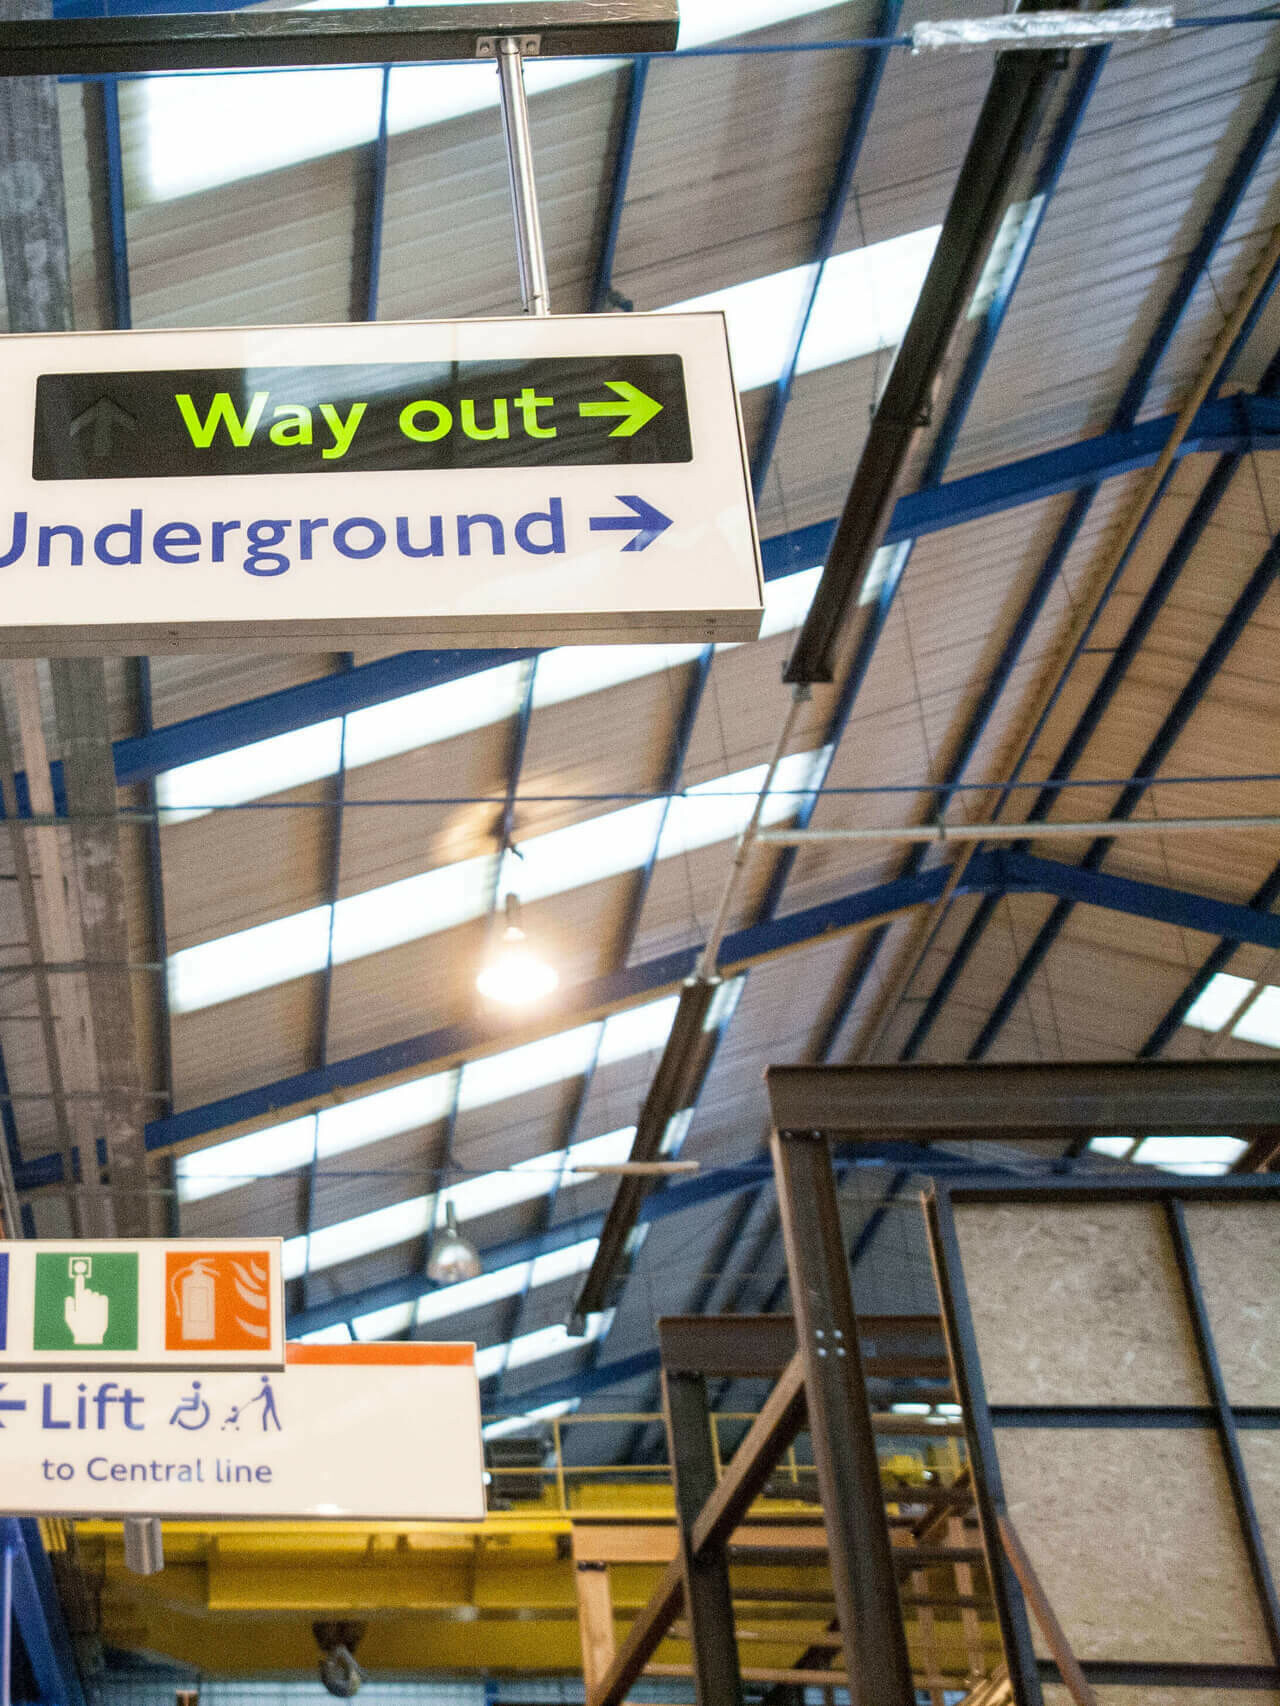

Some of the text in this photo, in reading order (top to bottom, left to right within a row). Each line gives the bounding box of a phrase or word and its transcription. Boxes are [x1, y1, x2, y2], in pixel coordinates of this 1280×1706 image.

[175, 388, 558, 460] Way out
[42, 1382, 145, 1431] Lift
[42, 1457, 273, 1484] to Central line
